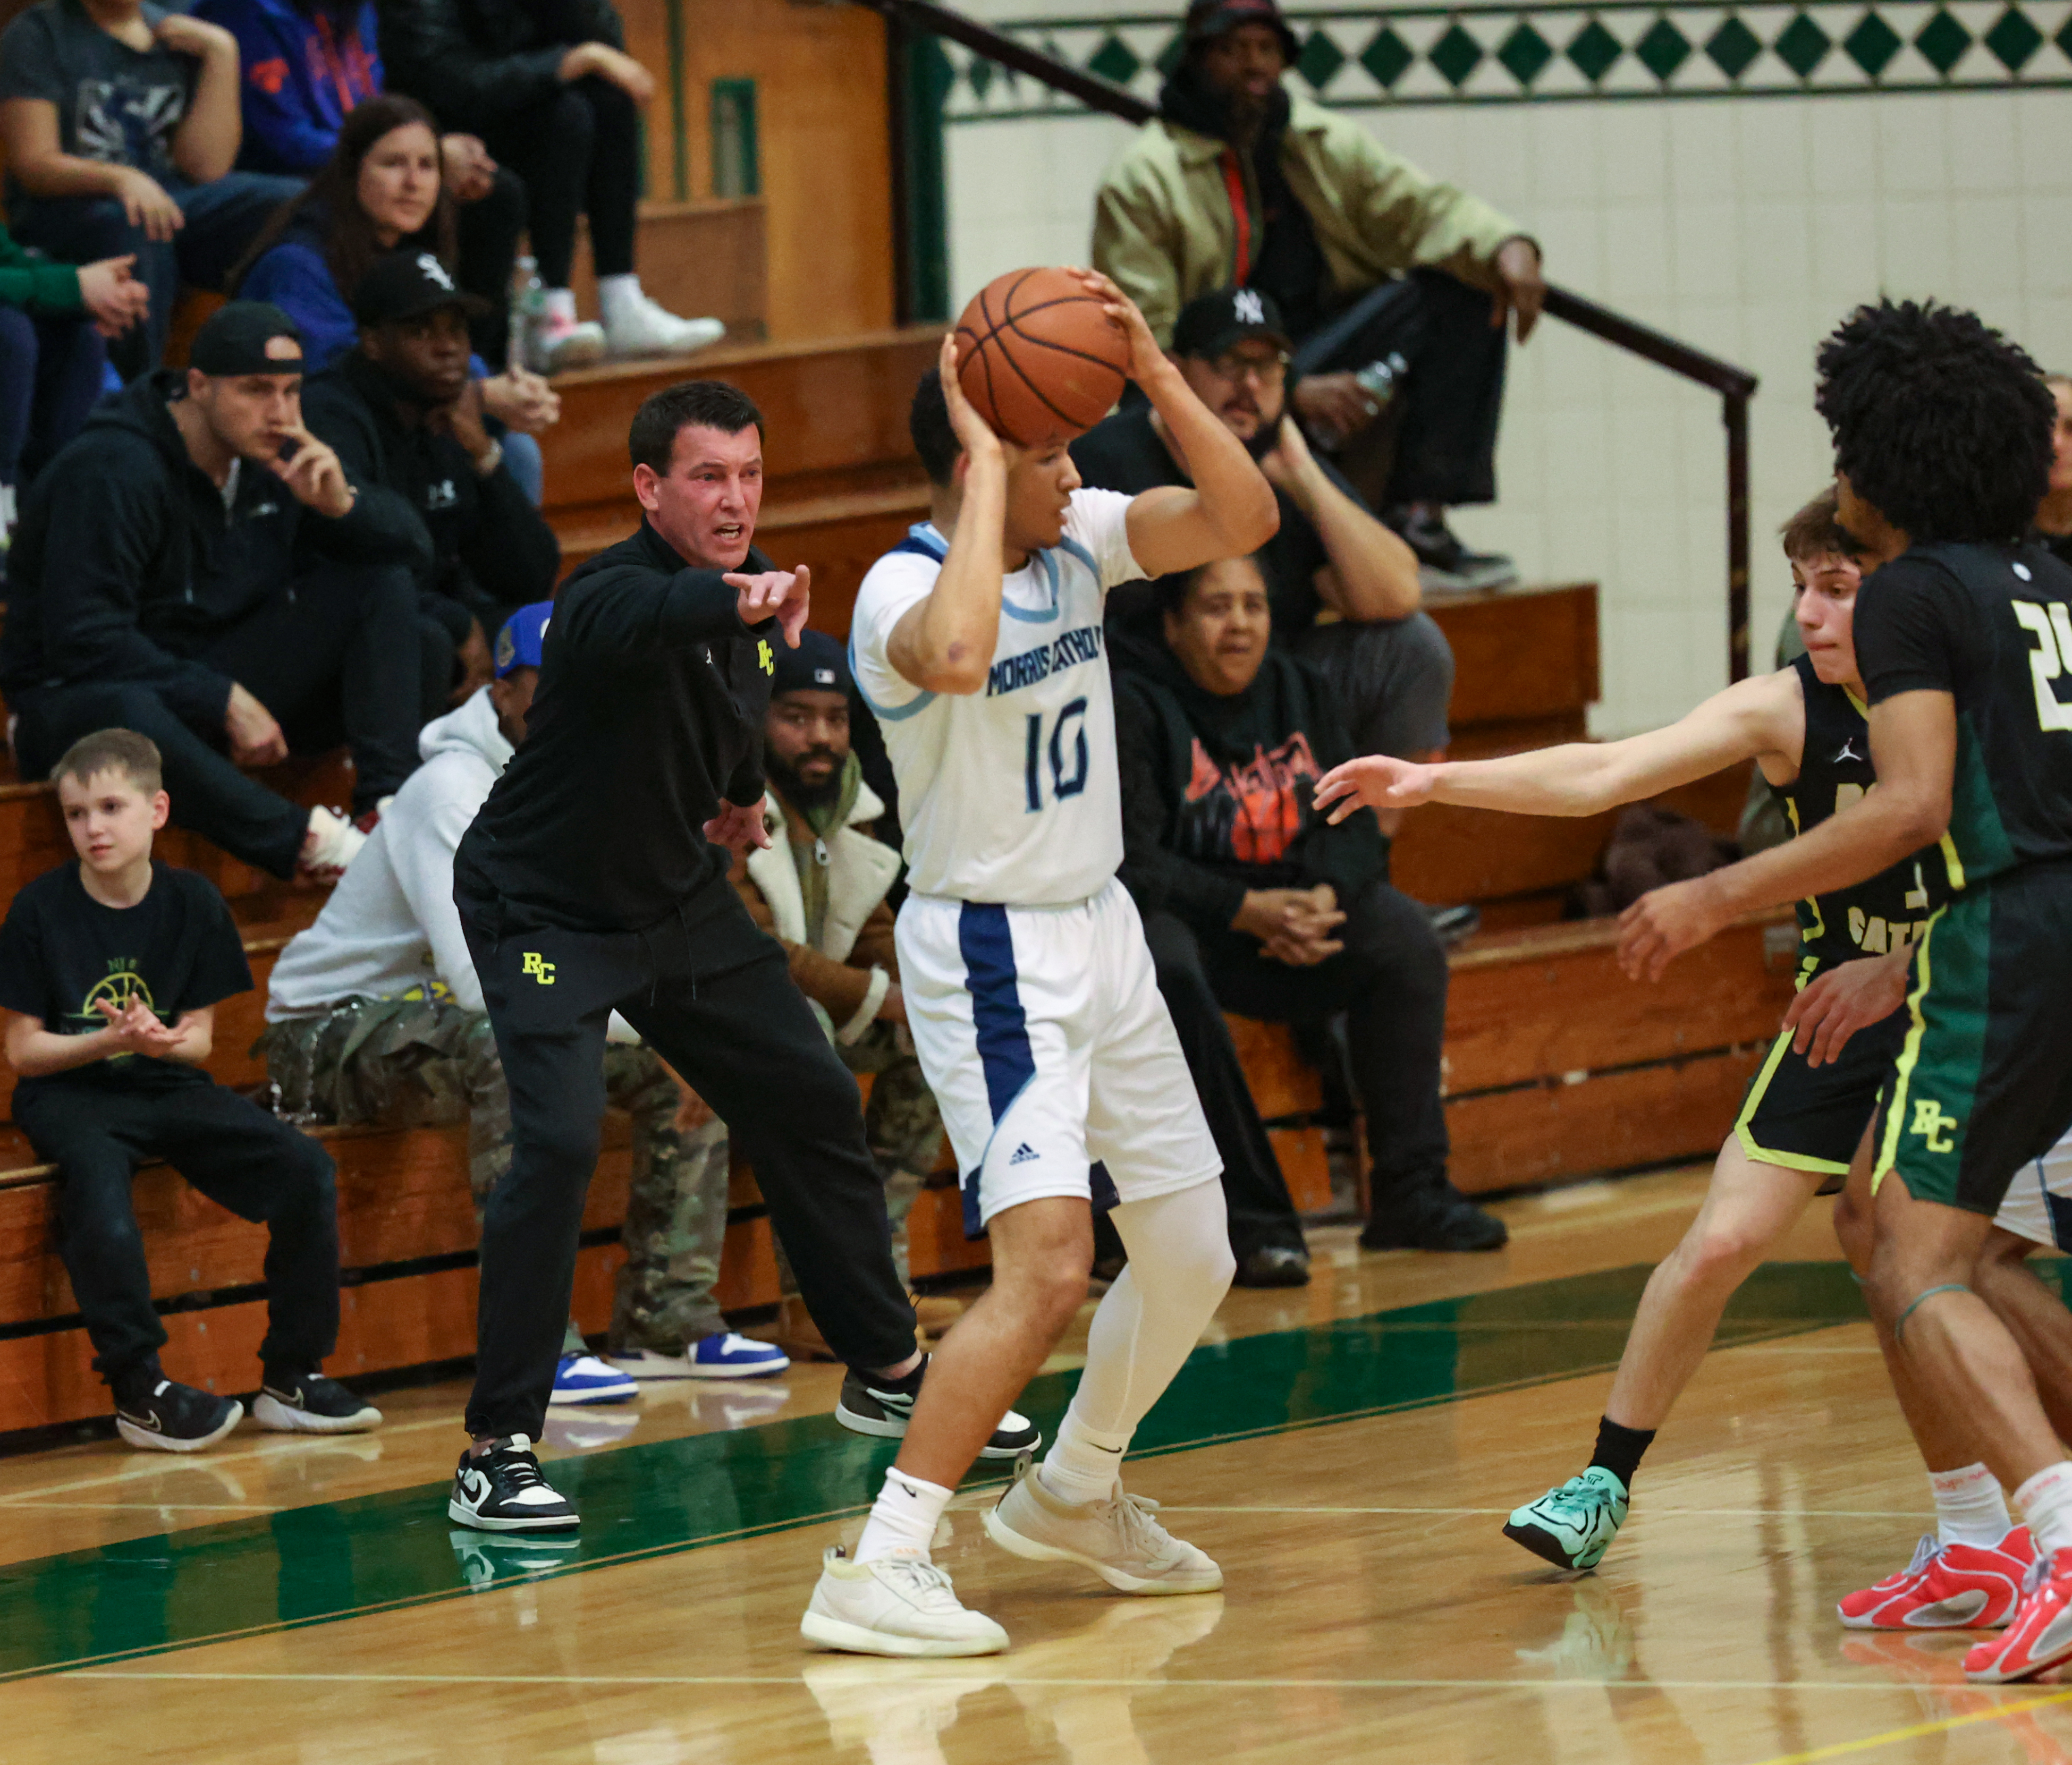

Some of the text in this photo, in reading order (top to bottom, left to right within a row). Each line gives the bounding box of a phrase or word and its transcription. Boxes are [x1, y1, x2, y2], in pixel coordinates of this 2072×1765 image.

[987, 645, 1050, 697] MORRIS
[1025, 696, 1089, 813] 10
[522, 952, 556, 985] RC
[1909, 1099, 1958, 1153] RC
